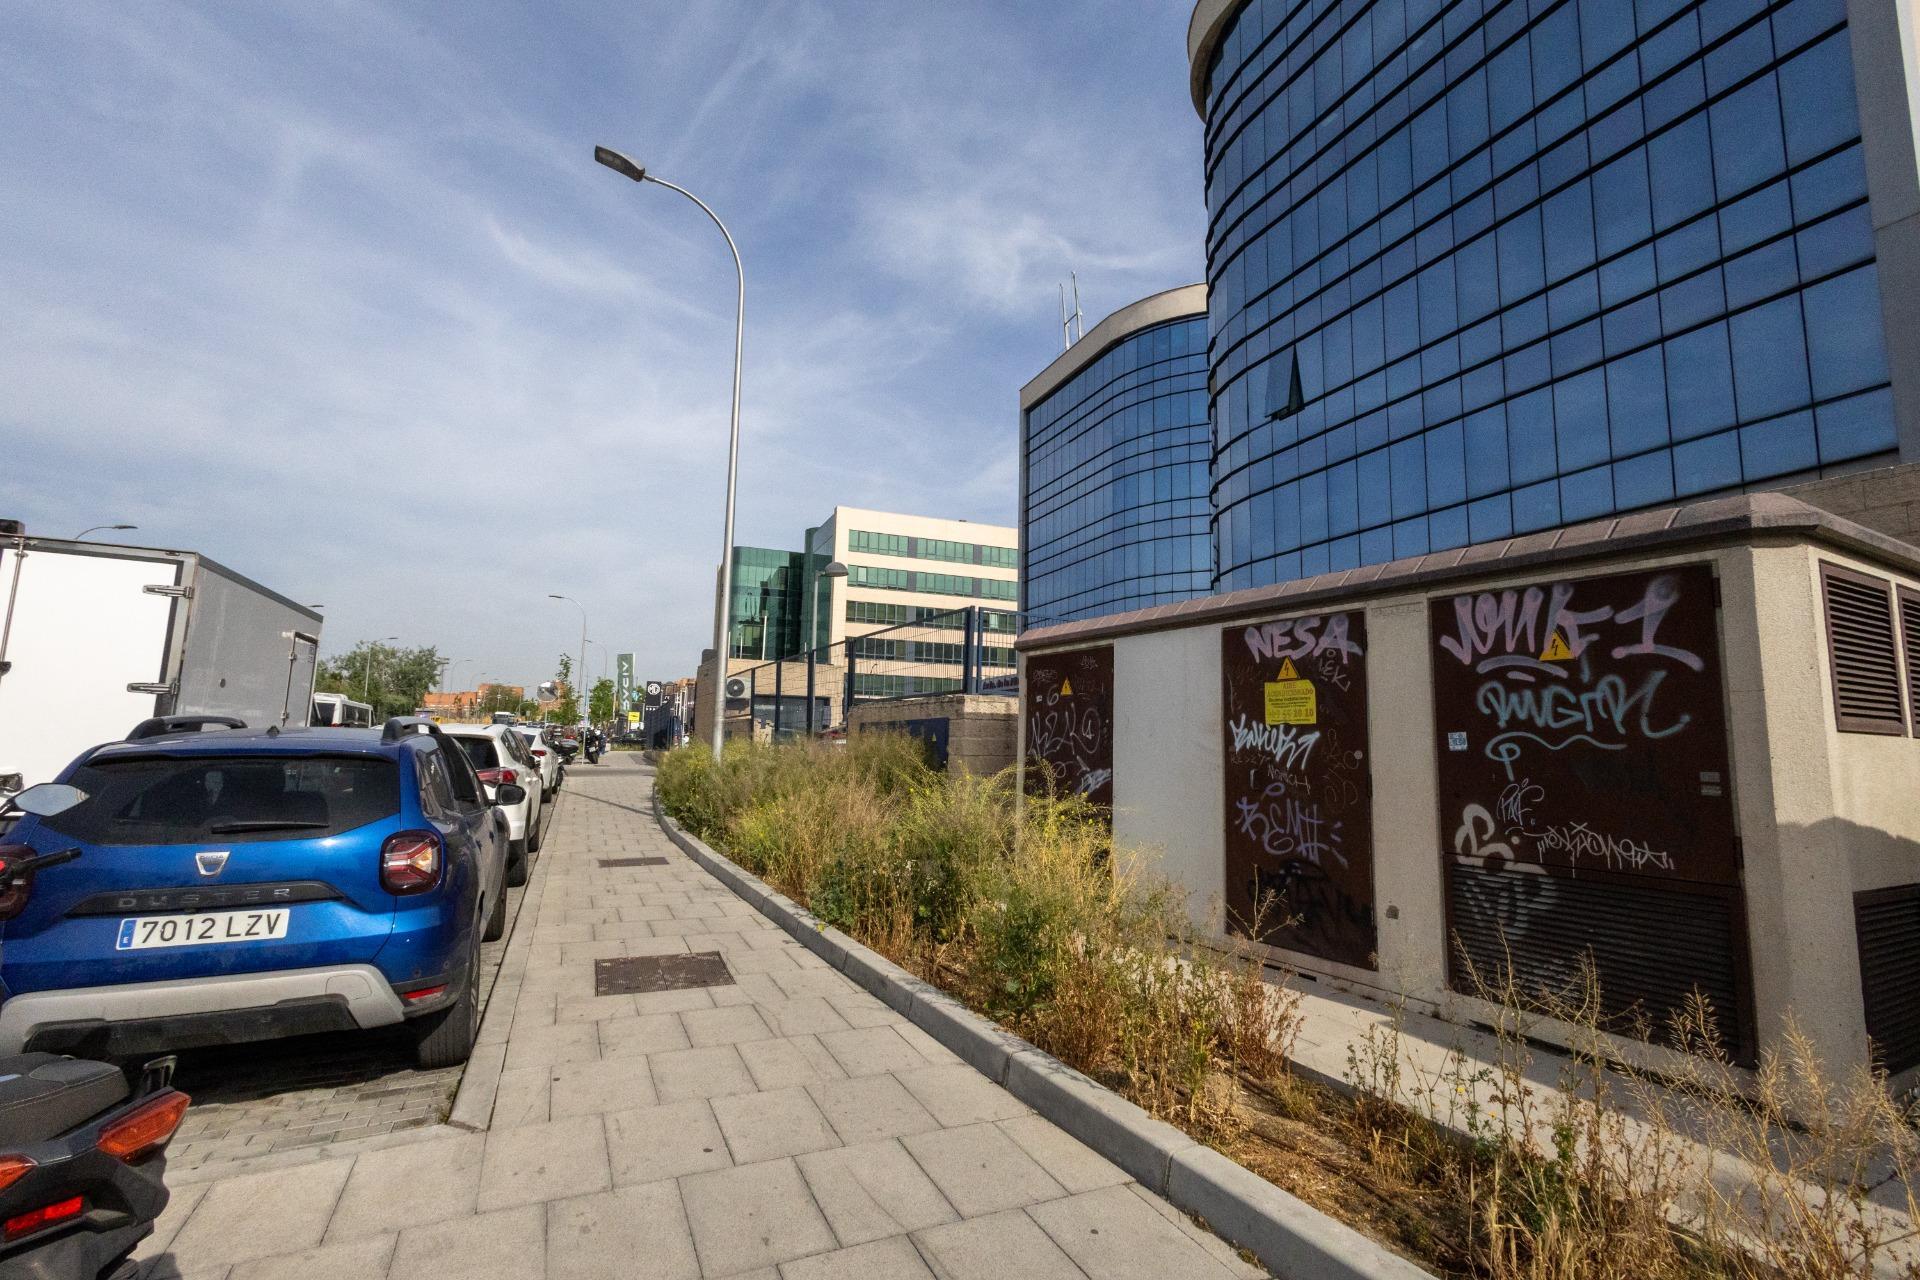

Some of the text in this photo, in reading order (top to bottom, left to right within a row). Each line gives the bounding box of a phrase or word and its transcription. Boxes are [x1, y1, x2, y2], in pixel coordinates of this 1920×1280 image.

[1244, 613, 1363, 664] NESA
[118, 888, 290, 909] DUSTER
[142, 918, 216, 944] 7012
[226, 913, 281, 938] LZV
